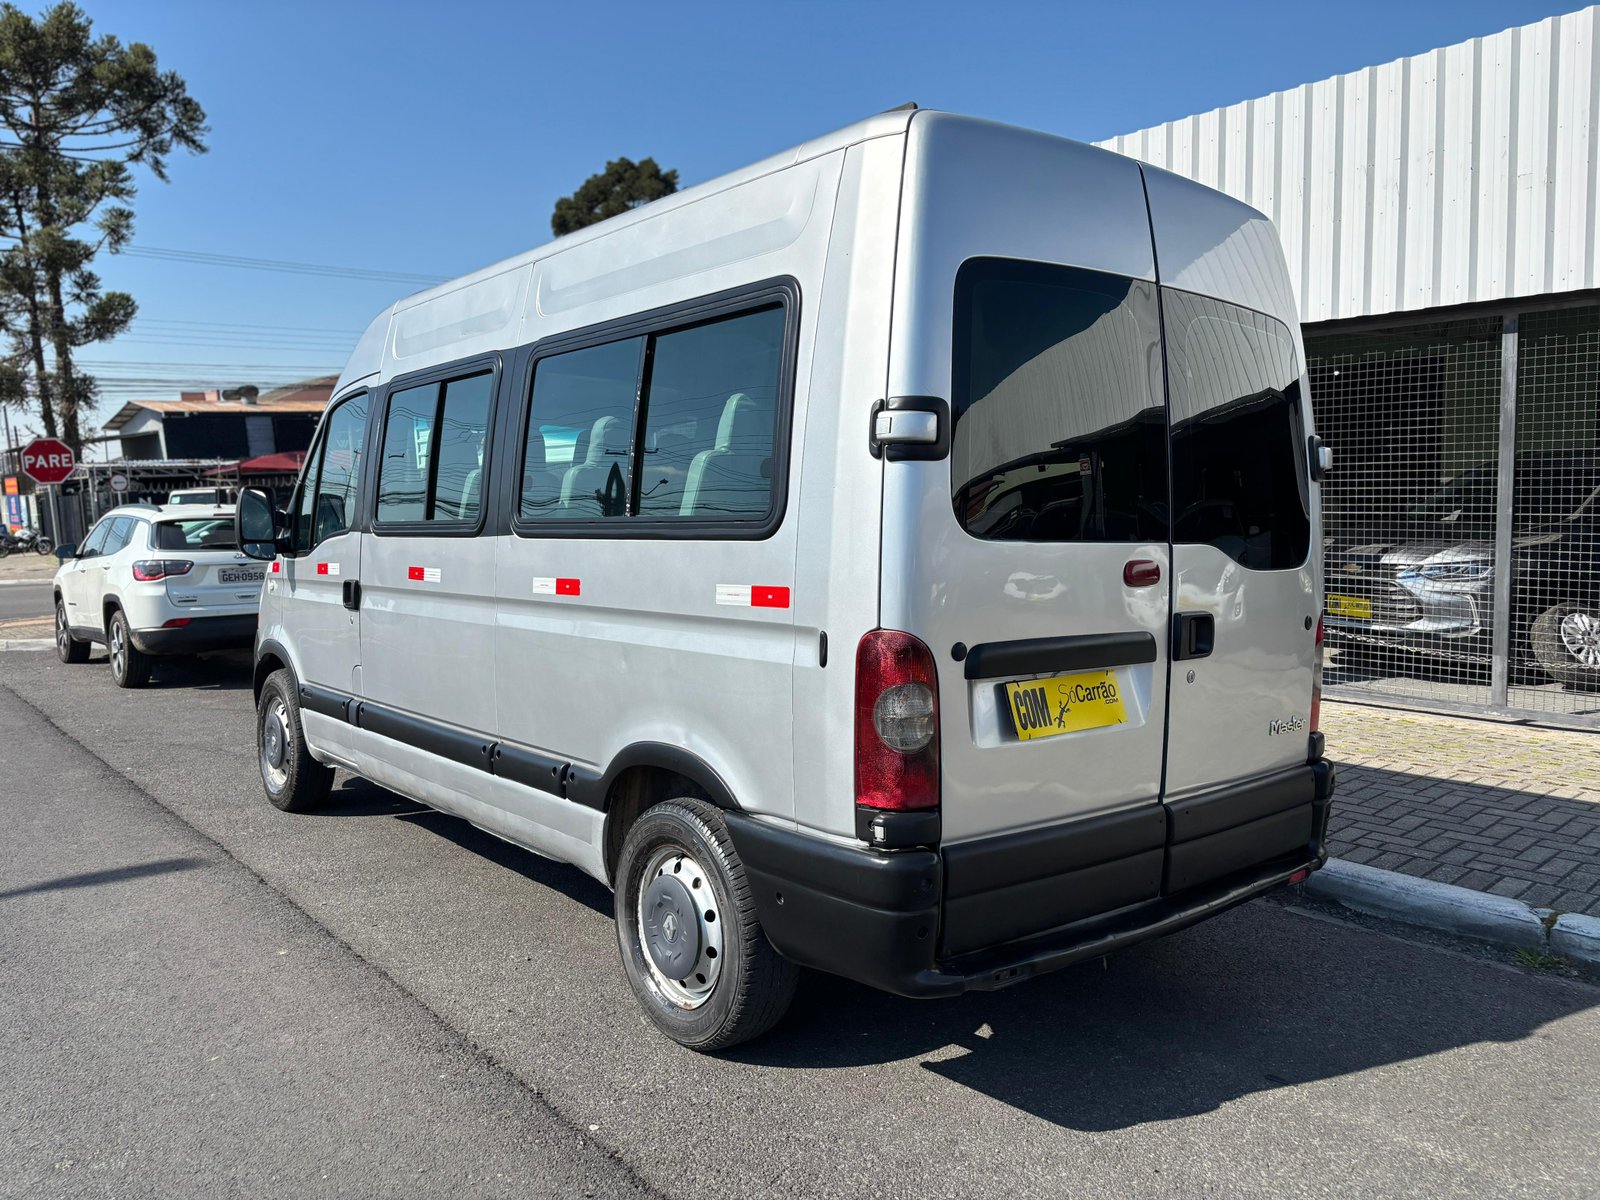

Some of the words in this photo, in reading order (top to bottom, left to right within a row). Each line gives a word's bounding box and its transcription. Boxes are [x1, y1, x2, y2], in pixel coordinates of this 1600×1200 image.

[24, 454, 72, 469] PARE
[1013, 687, 1053, 731] COM
[1268, 715, 1307, 736] Master
